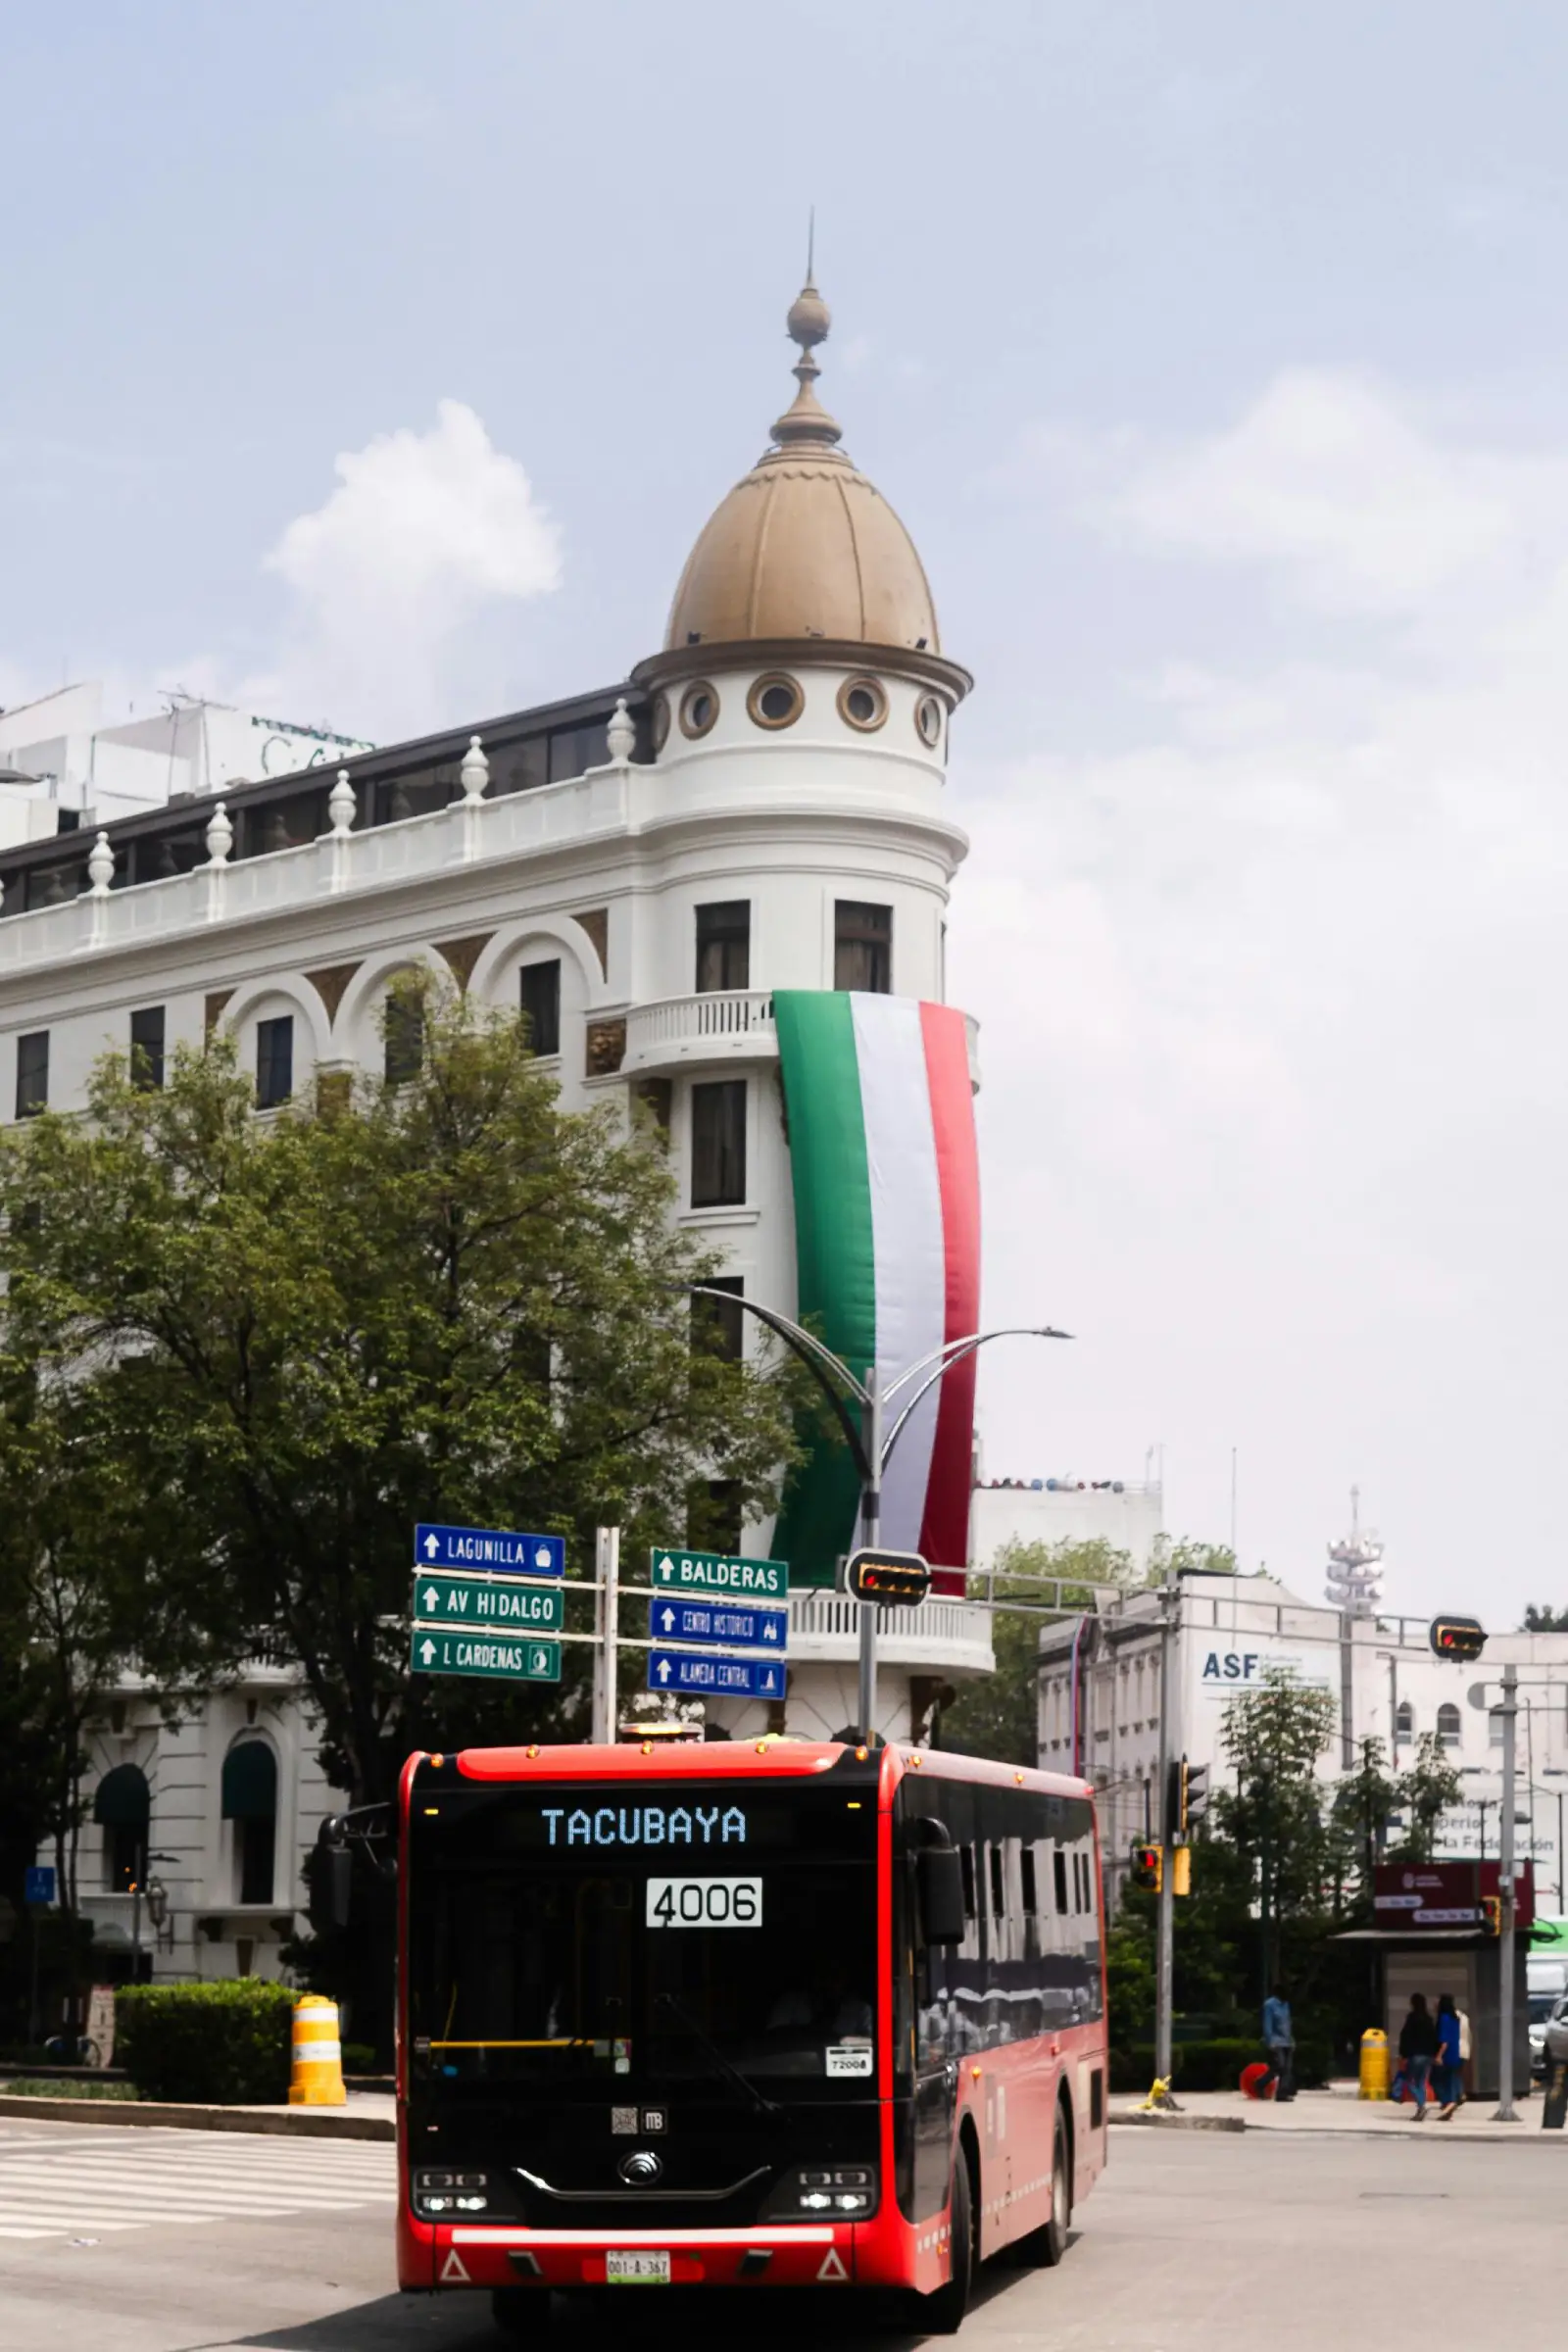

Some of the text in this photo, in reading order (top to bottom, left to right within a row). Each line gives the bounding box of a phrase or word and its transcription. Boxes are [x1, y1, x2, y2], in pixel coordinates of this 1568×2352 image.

[448, 1537, 524, 1564] LAGUNILLA
[681, 1559, 778, 1592] BALDERAS
[447, 1590, 554, 1620] AV HIDALGO
[683, 1610, 754, 1638] CENTRO HISTORICO
[443, 1642, 522, 1671] L CARDENAS
[1202, 1652, 1258, 1679] ASF
[680, 1662, 750, 1688] ALAMEDA CENTRAL
[542, 1806, 746, 1845] TACUBAYA
[654, 1884, 757, 1921] 4006
